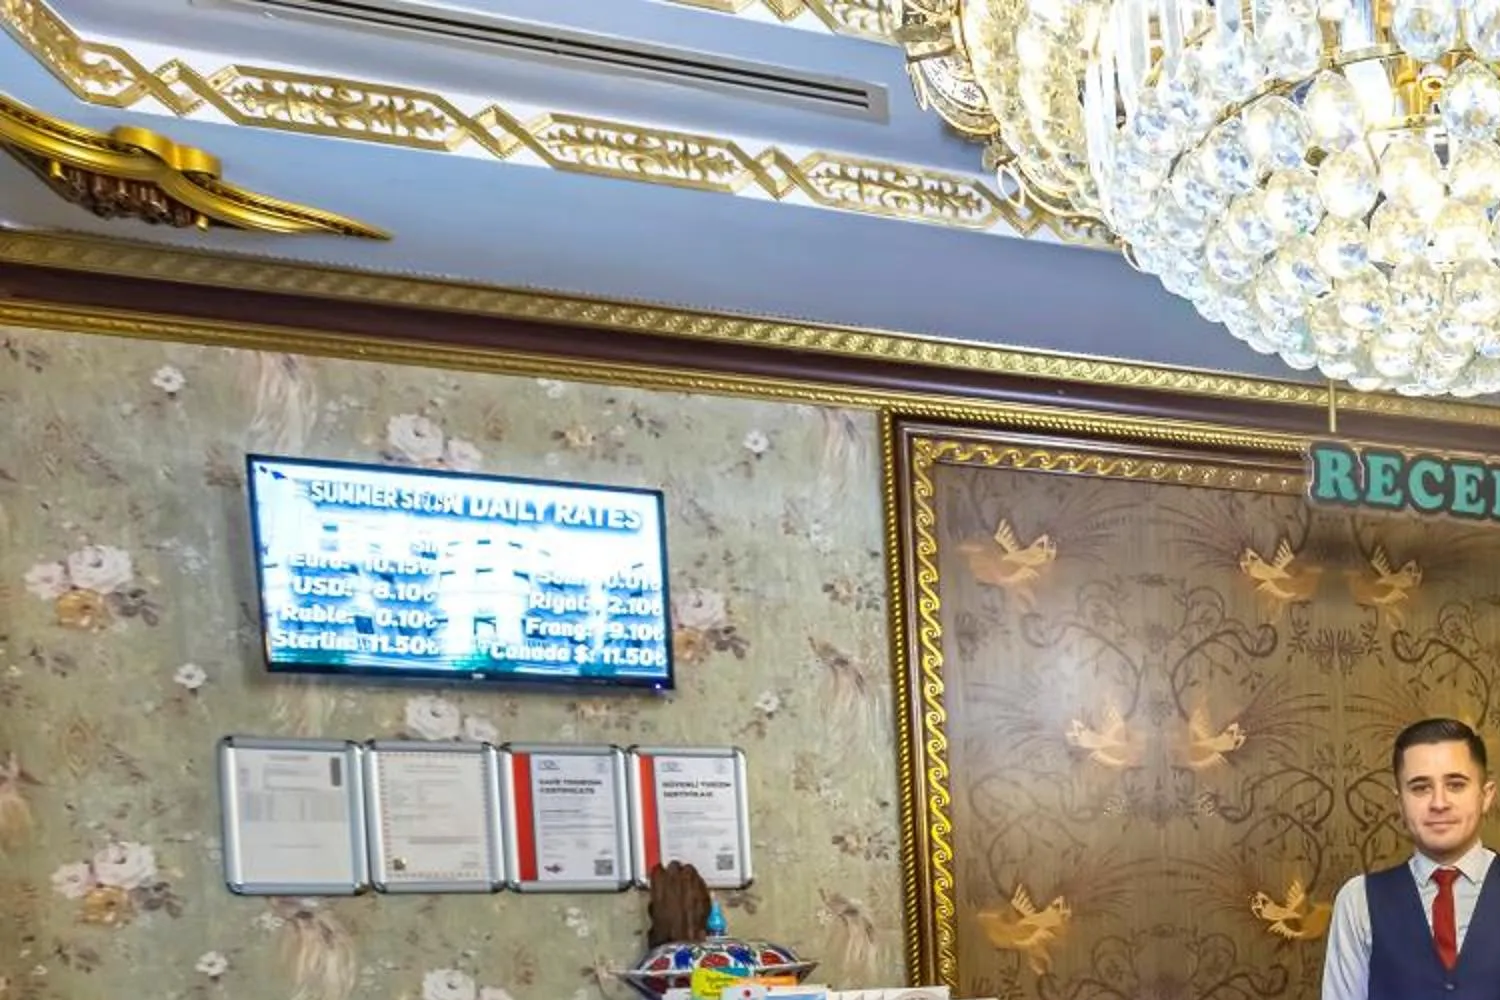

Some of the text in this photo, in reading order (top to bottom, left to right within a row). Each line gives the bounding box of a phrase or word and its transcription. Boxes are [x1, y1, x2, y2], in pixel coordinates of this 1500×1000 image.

[311, 479, 398, 508] SUMMER
[469, 494, 549, 521] DAILY
[555, 501, 642, 529] RATES
